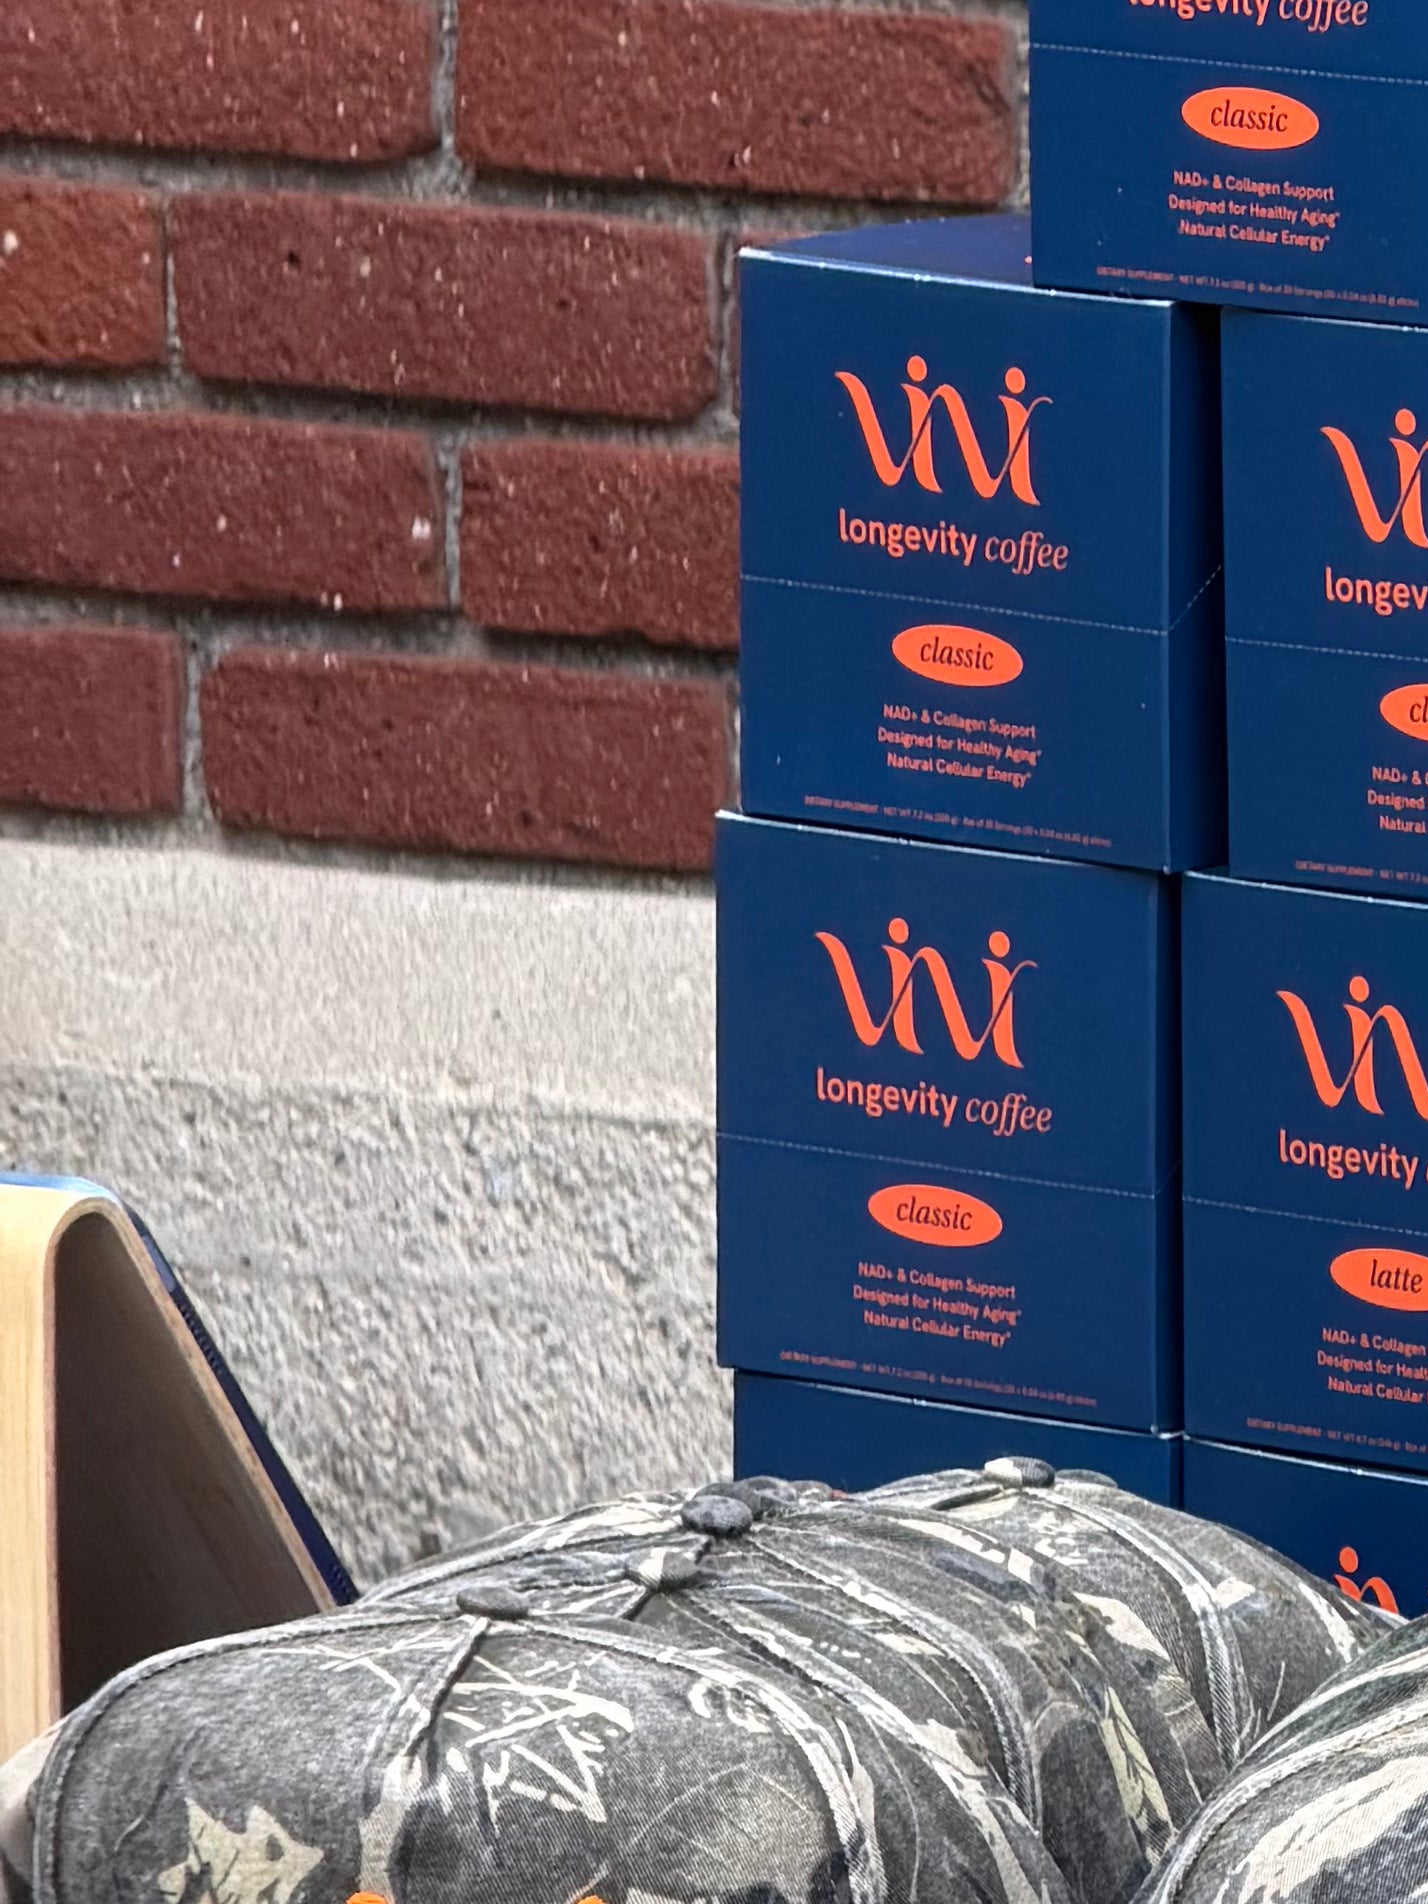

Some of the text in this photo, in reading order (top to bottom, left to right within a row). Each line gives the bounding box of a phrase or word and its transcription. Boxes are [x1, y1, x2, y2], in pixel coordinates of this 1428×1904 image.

[1210, 99, 1288, 132] classic
[838, 509, 1068, 576] longevity coffee
[920, 636, 994, 671] classic
[816, 1067, 1052, 1138] longevity coffee
[1278, 1129, 1419, 1190] longevity
[896, 1196, 973, 1231] classic
[1370, 1258, 1423, 1294] latte
